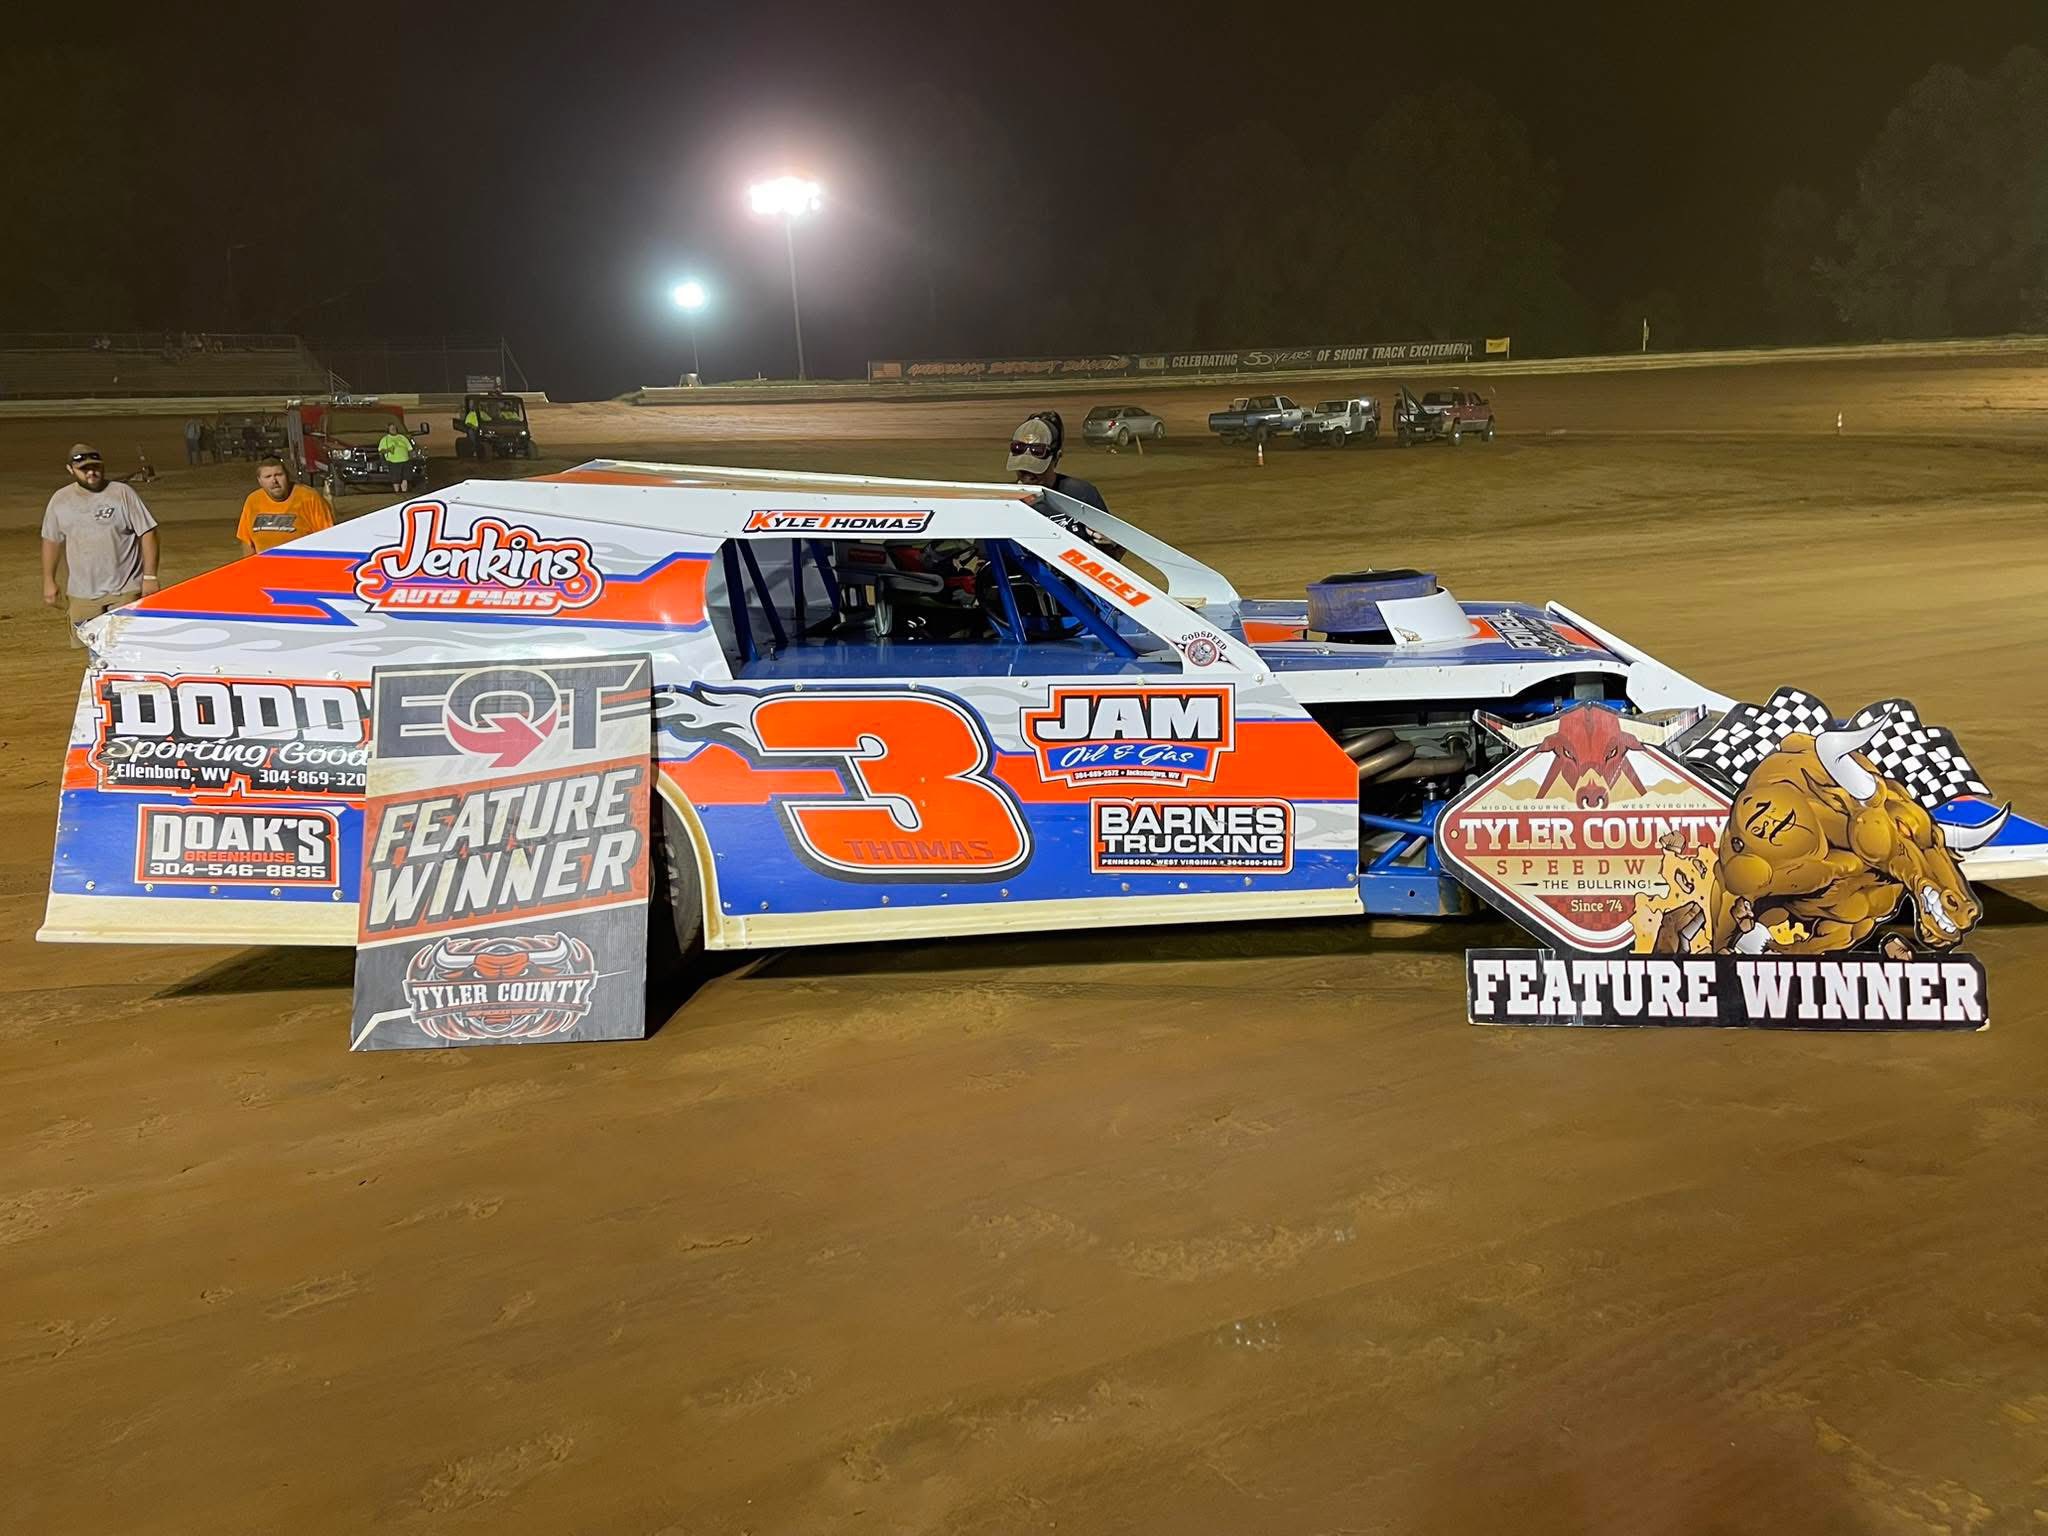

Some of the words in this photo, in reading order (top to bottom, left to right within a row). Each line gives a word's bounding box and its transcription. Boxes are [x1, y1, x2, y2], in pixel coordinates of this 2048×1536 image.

[1171, 353, 1239, 368] CELEBRATING
[1243, 351, 1273, 366] 50
[1274, 350, 1312, 364] YEARS
[1316, 349, 1331, 362] OF
[1333, 348, 1368, 361] SHORT
[1371, 346, 1406, 359] TRACK
[381, 510, 581, 589] Jenkins
[387, 588, 460, 606] AUTO
[465, 590, 559, 607] PARTS
[1181, 630, 1228, 651] GODSPEED
[373, 658, 648, 768] EQT
[1036, 697, 1220, 740] JAM
[106, 736, 268, 768] Sporting
[278, 741, 369, 768] Good
[1061, 745, 1106, 768] Oil
[1113, 744, 1133, 759] &
[1138, 744, 1195, 766] Gas
[116, 763, 196, 782] Ellenboro,
[200, 766, 230, 781] WV
[258, 769, 367, 787] 304-869-320
[750, 691, 1032, 876] 3
[373, 768, 638, 864] FEATURE
[1101, 807, 1285, 835] BARNES
[151, 814, 326, 864] DOAK'S
[1101, 835, 1284, 854] TRUCKING
[1459, 818, 1576, 850] TYLER
[1583, 816, 1730, 849] COUNTY
[184, 851, 295, 863] GREENHOUSE
[843, 840, 994, 861] THOMAS
[150, 862, 326, 878] 304-546-8835
[1102, 859, 1154, 867] PENNSBORO,
[1497, 860, 1662, 875] SPEEDW
[367, 831, 638, 926] WINNER
[1543, 880, 1569, 889] THE
[1577, 880, 1652, 889] BULLRING!
[1571, 901, 1603, 912] Since
[1606, 900, 1623, 912] '74
[412, 983, 488, 1012] TYLER
[497, 979, 591, 1004] COUNTY
[1473, 959, 1718, 1018] FEATURE
[1737, 962, 1982, 1020] WINNER
